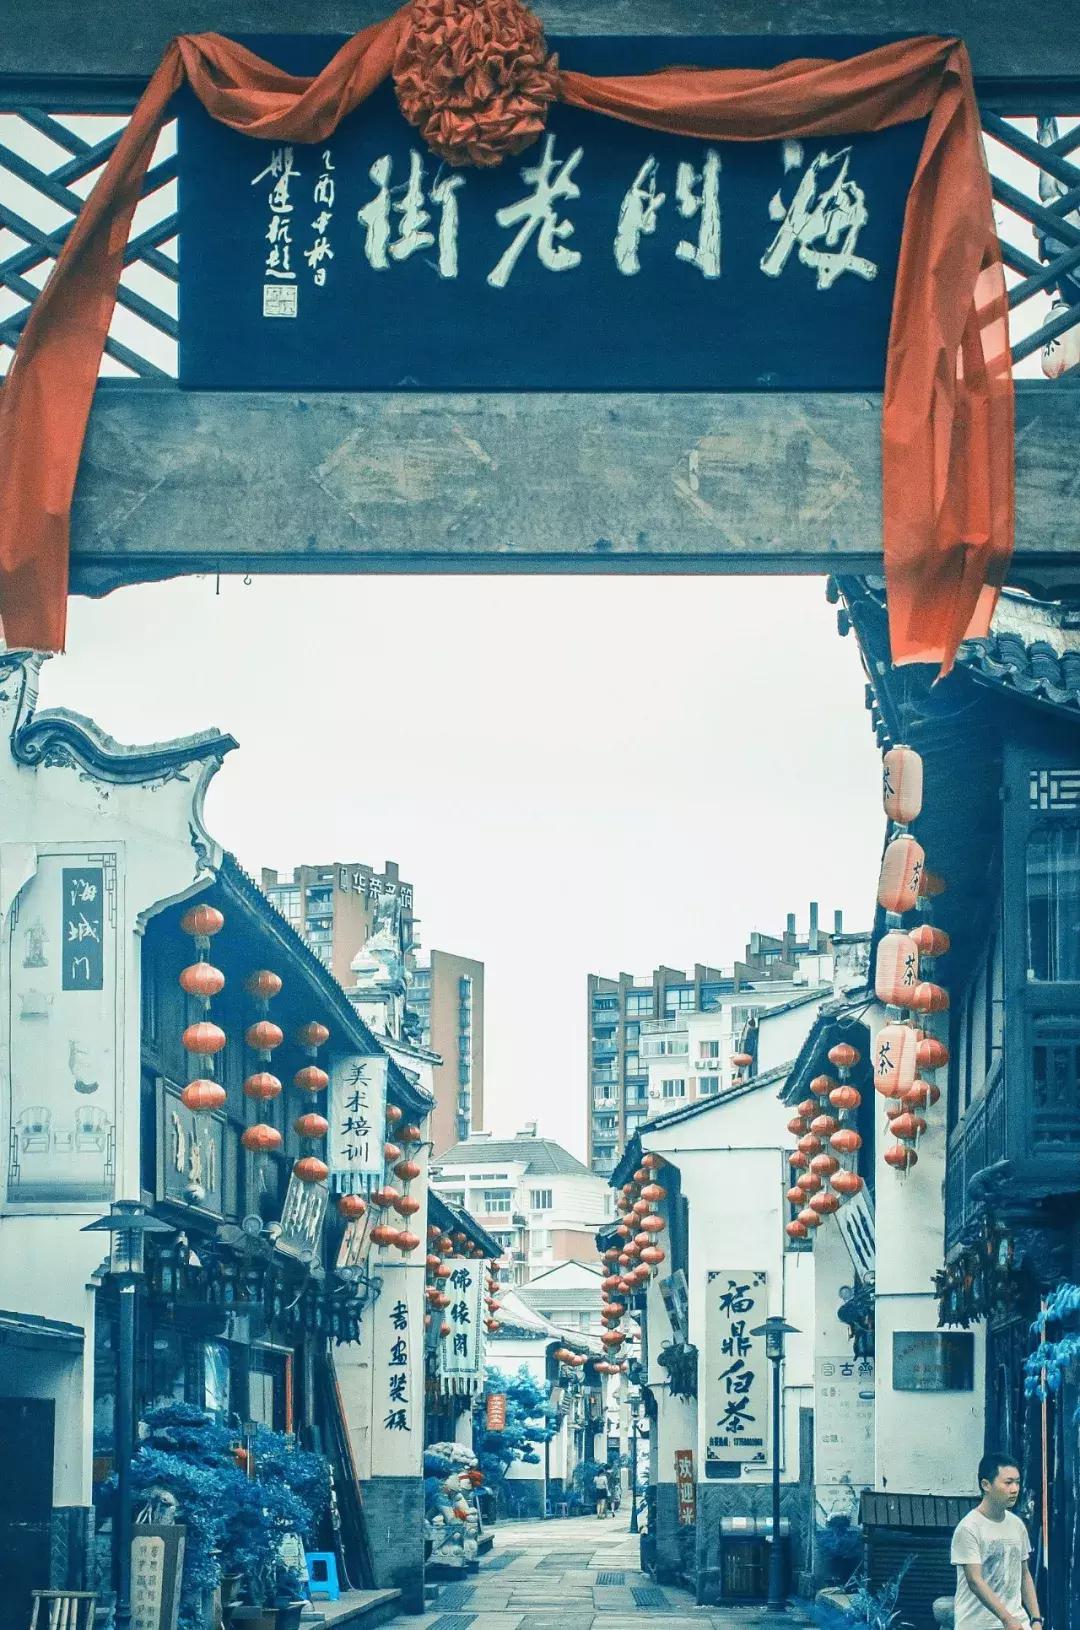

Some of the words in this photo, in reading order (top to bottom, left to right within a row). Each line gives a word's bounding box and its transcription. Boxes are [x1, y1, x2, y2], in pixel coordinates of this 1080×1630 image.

[903, 953, 917, 986] 茶
[877, 1041, 895, 1076] 茶
[341, 1063, 372, 1163] 美术培训
[717, 1281, 756, 1433] 福鼎白茶
